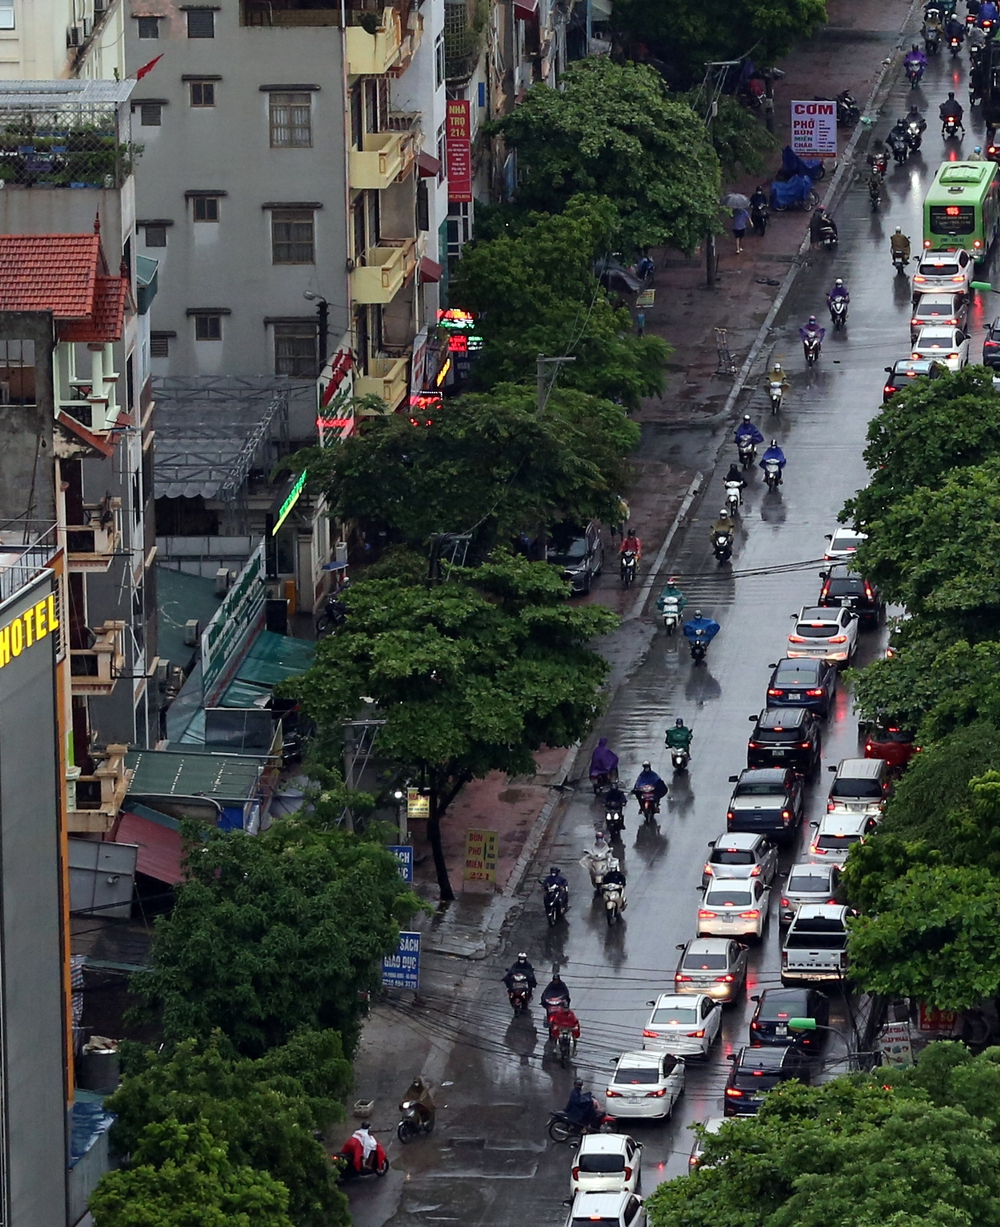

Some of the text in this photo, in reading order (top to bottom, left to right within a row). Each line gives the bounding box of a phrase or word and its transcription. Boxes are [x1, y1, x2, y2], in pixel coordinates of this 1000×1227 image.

[449, 104, 466, 114] NHÀ
[794, 104, 834, 115] CƠM
[450, 117, 466, 127] TRỌ
[450, 128, 466, 137] 214
[0, 594, 59, 668] HOTEL
[470, 872, 489, 880] 221
[400, 936, 418, 952] SÁCH
